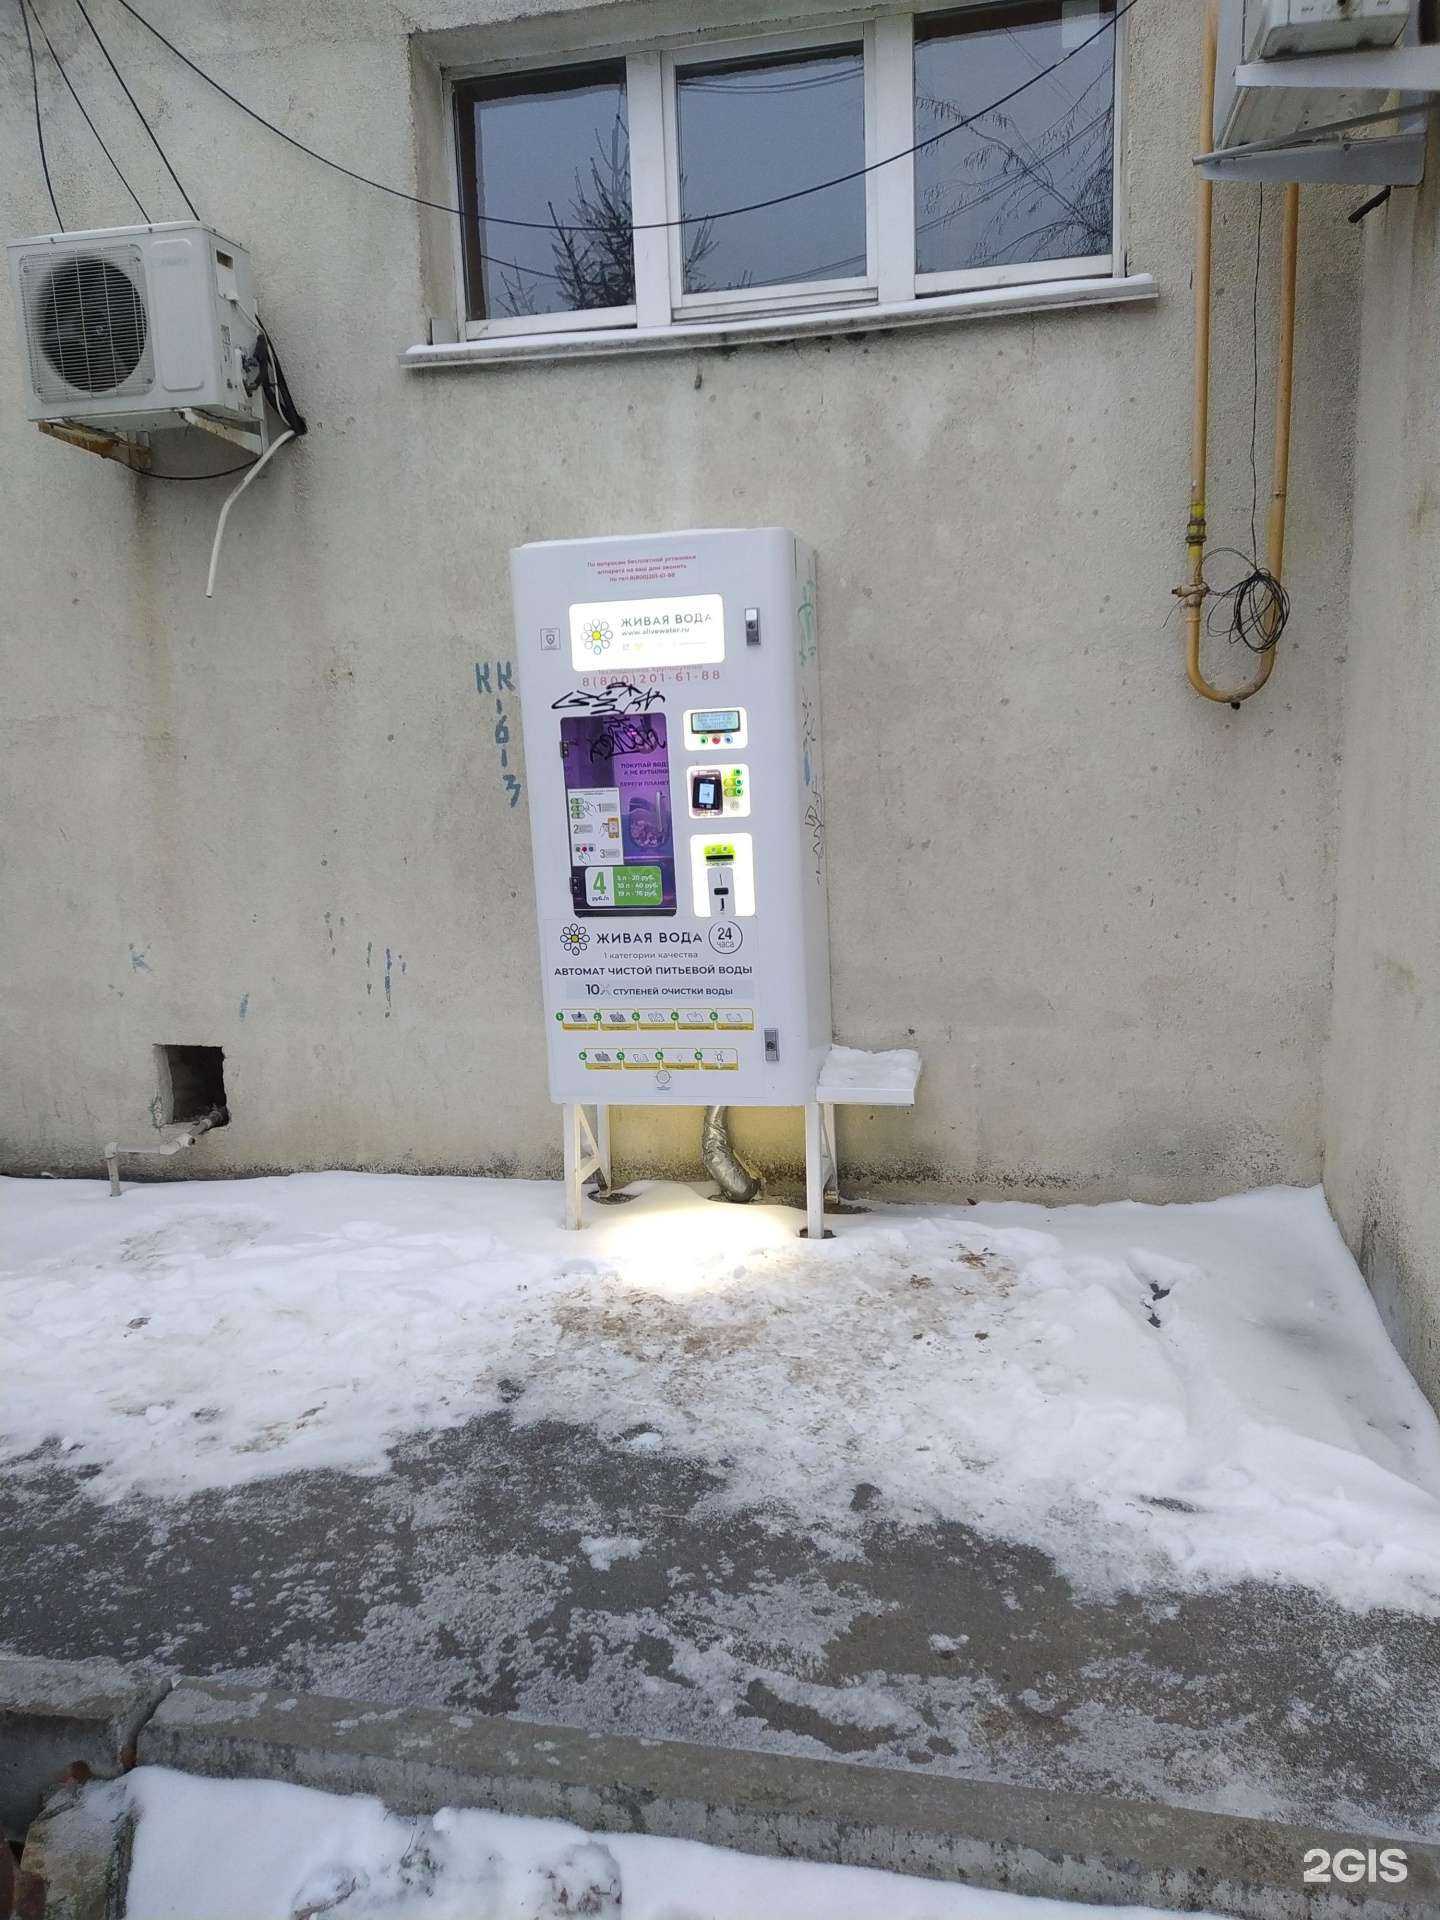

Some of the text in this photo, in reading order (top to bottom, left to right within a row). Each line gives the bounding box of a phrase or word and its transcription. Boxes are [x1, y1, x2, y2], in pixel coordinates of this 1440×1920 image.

[621, 613, 712, 627] ЖИВАЯ ВОДА
[621, 627, 690, 636] www.alivewater.ru
[582, 670, 720, 688] 8(800)201-61-88
[593, 871, 606, 894] 4
[596, 932, 703, 944] ЖИВАЯ ВОДА
[717, 927, 733, 940] 24
[717, 940, 735, 949] часа
[609, 951, 656, 960] категории
[658, 951, 698, 959] качества
[554, 964, 753, 976] АВТОМАТ ЧИСТОЙ ПИТЬЕВОЙ ВОДЫ
[585, 983, 600, 995] 10
[612, 986, 659, 996] СТУПЕНЕЙ
[661, 987, 704, 995] ОЧИСТКИ
[706, 987, 733, 995] ВОДЫ
